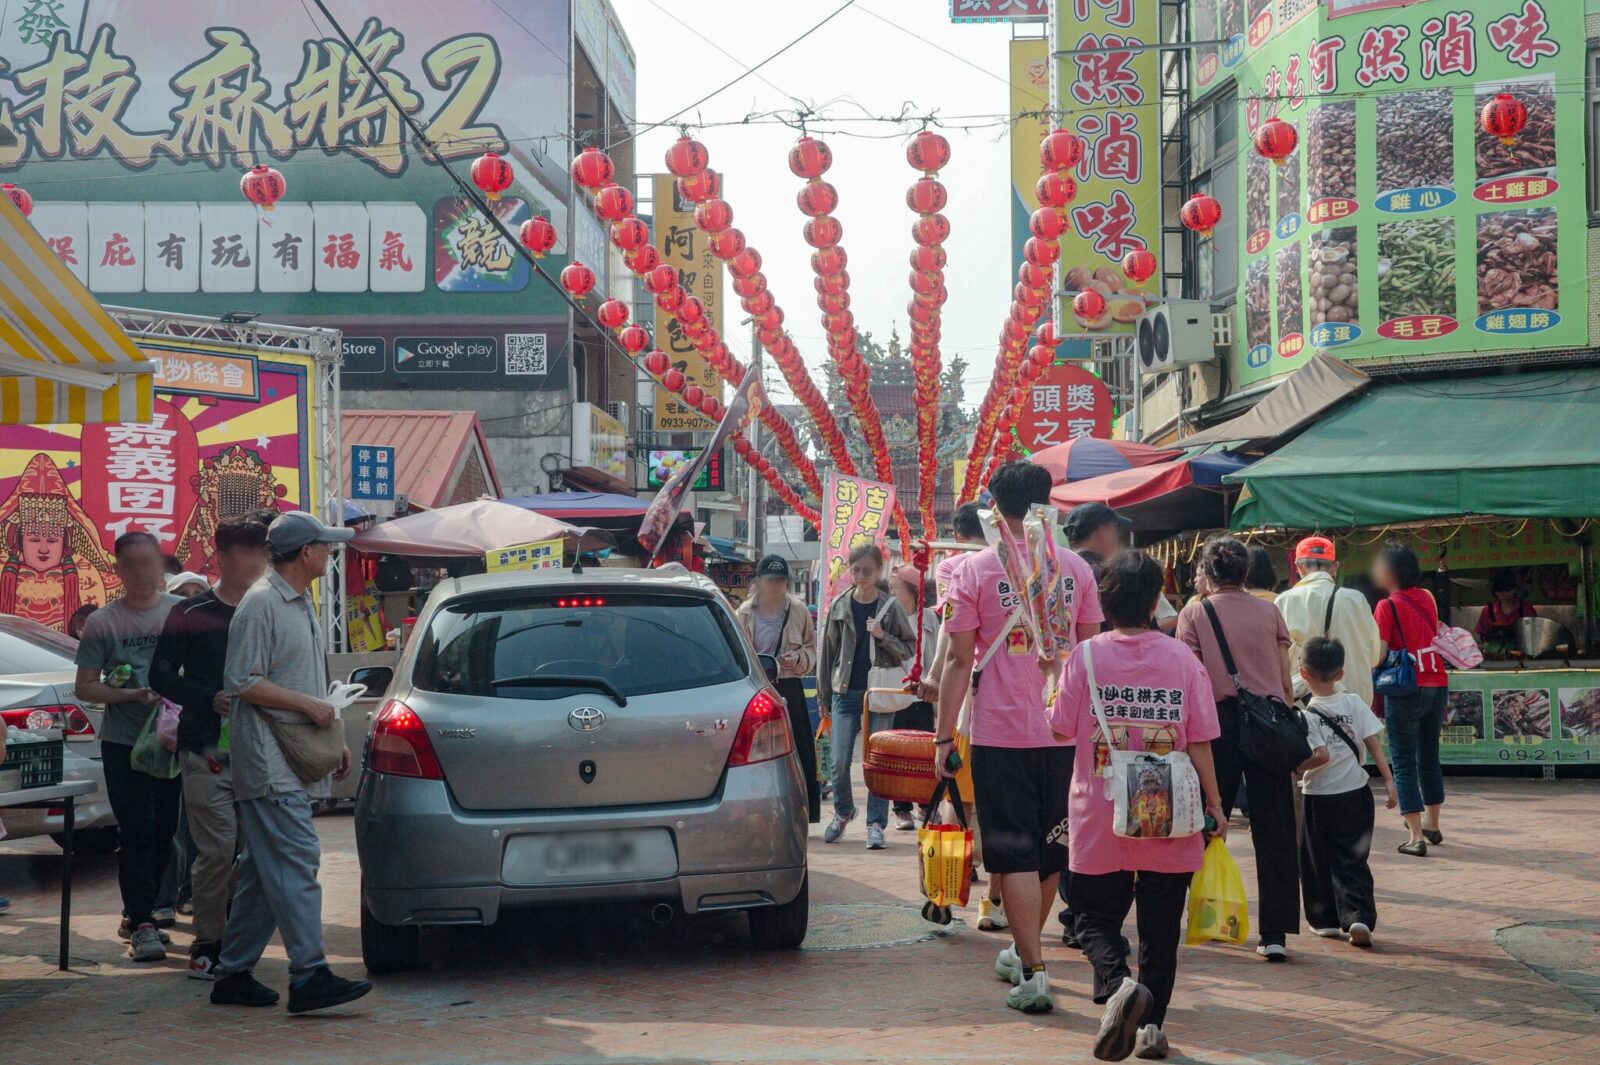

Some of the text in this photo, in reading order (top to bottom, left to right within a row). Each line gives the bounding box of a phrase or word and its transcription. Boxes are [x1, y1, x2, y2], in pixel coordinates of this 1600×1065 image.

[0, 20, 505, 176] 技麻將2
[1485, 180, 1548, 200] 土雞腳
[1390, 191, 1441, 211] 雞心
[48, 233, 413, 272] 保庇有玩有福氣
[1394, 318, 1442, 337] 毛豆
[1486, 314, 1550, 331] 雞翅膀
[342, 342, 376, 355] Store
[417, 342, 493, 358] Google play
[418, 360, 449, 368] 立即下載
[1033, 384, 1095, 413] 頭獎
[358, 450, 371, 495] 停車場
[376, 467, 388, 495] 廟前
[122, 635, 157, 648] FACTO
